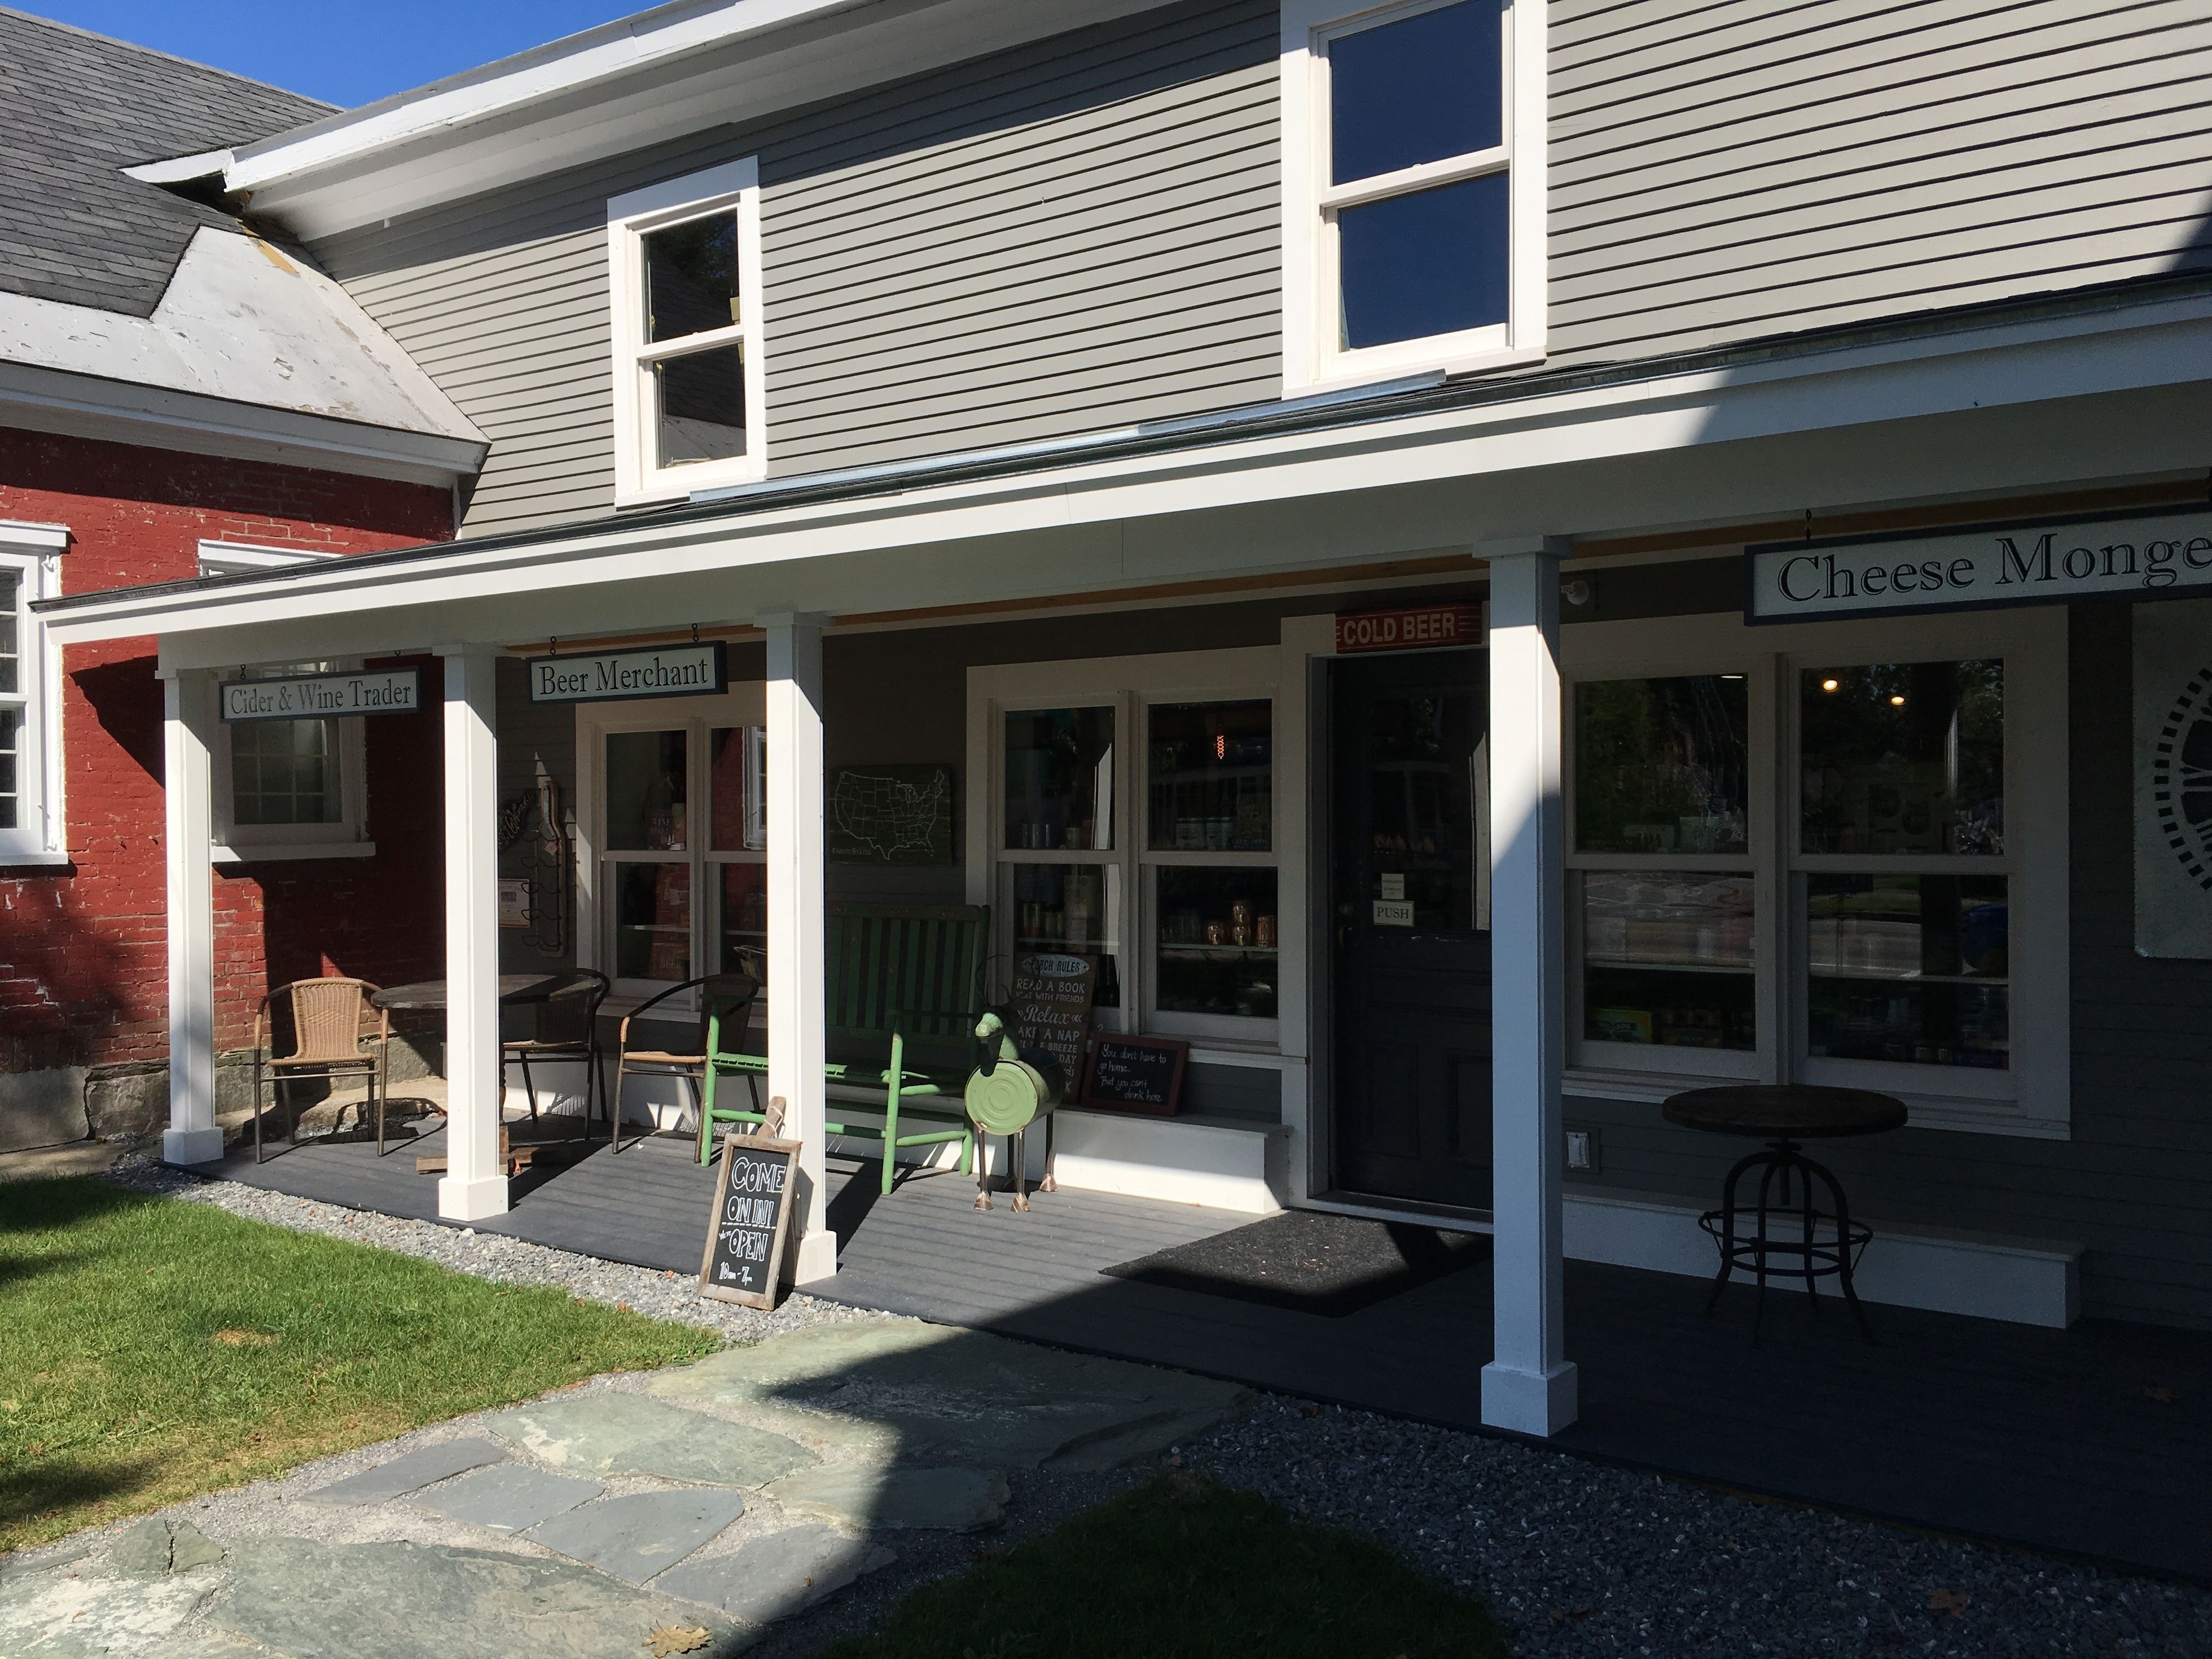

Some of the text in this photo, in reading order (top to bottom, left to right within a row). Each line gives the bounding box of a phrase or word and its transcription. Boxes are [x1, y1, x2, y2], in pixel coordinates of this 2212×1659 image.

[1777, 554, 1976, 603] Cheese
[1343, 612, 1456, 645] COLD BEER
[539, 656, 708, 695] Beer Merchant
[230, 678, 411, 714] Cider & Wine Trader
[1377, 907, 1409, 919] PUSH
[1056, 961, 1081, 973] RULES
[1046, 980, 1054, 992] A
[1059, 982, 1086, 994] BOOK
[1035, 993, 1054, 1001] WITH
[1055, 994, 1085, 1003] FRIENDS
[1023, 1004, 1070, 1025] Relax
[1043, 1028, 1052, 1040] A
[1057, 1029, 1081, 1042] NAP
[1048, 1042, 1079, 1054] BREEZE
[1102, 1044, 1116, 1058] You
[1140, 1051, 1156, 1062] have
[1158, 1053, 1166, 1063] to
[1059, 1054, 1078, 1065] DAY
[1097, 1063, 1107, 1074] go
[1100, 1075, 1114, 1087] But
[1115, 1080, 1128, 1091] you
[1124, 1088, 1144, 1100] drink
[732, 1156, 786, 1193] COME
[728, 1195, 774, 1226] ON IN!
[729, 1228, 768, 1261] OPEN
